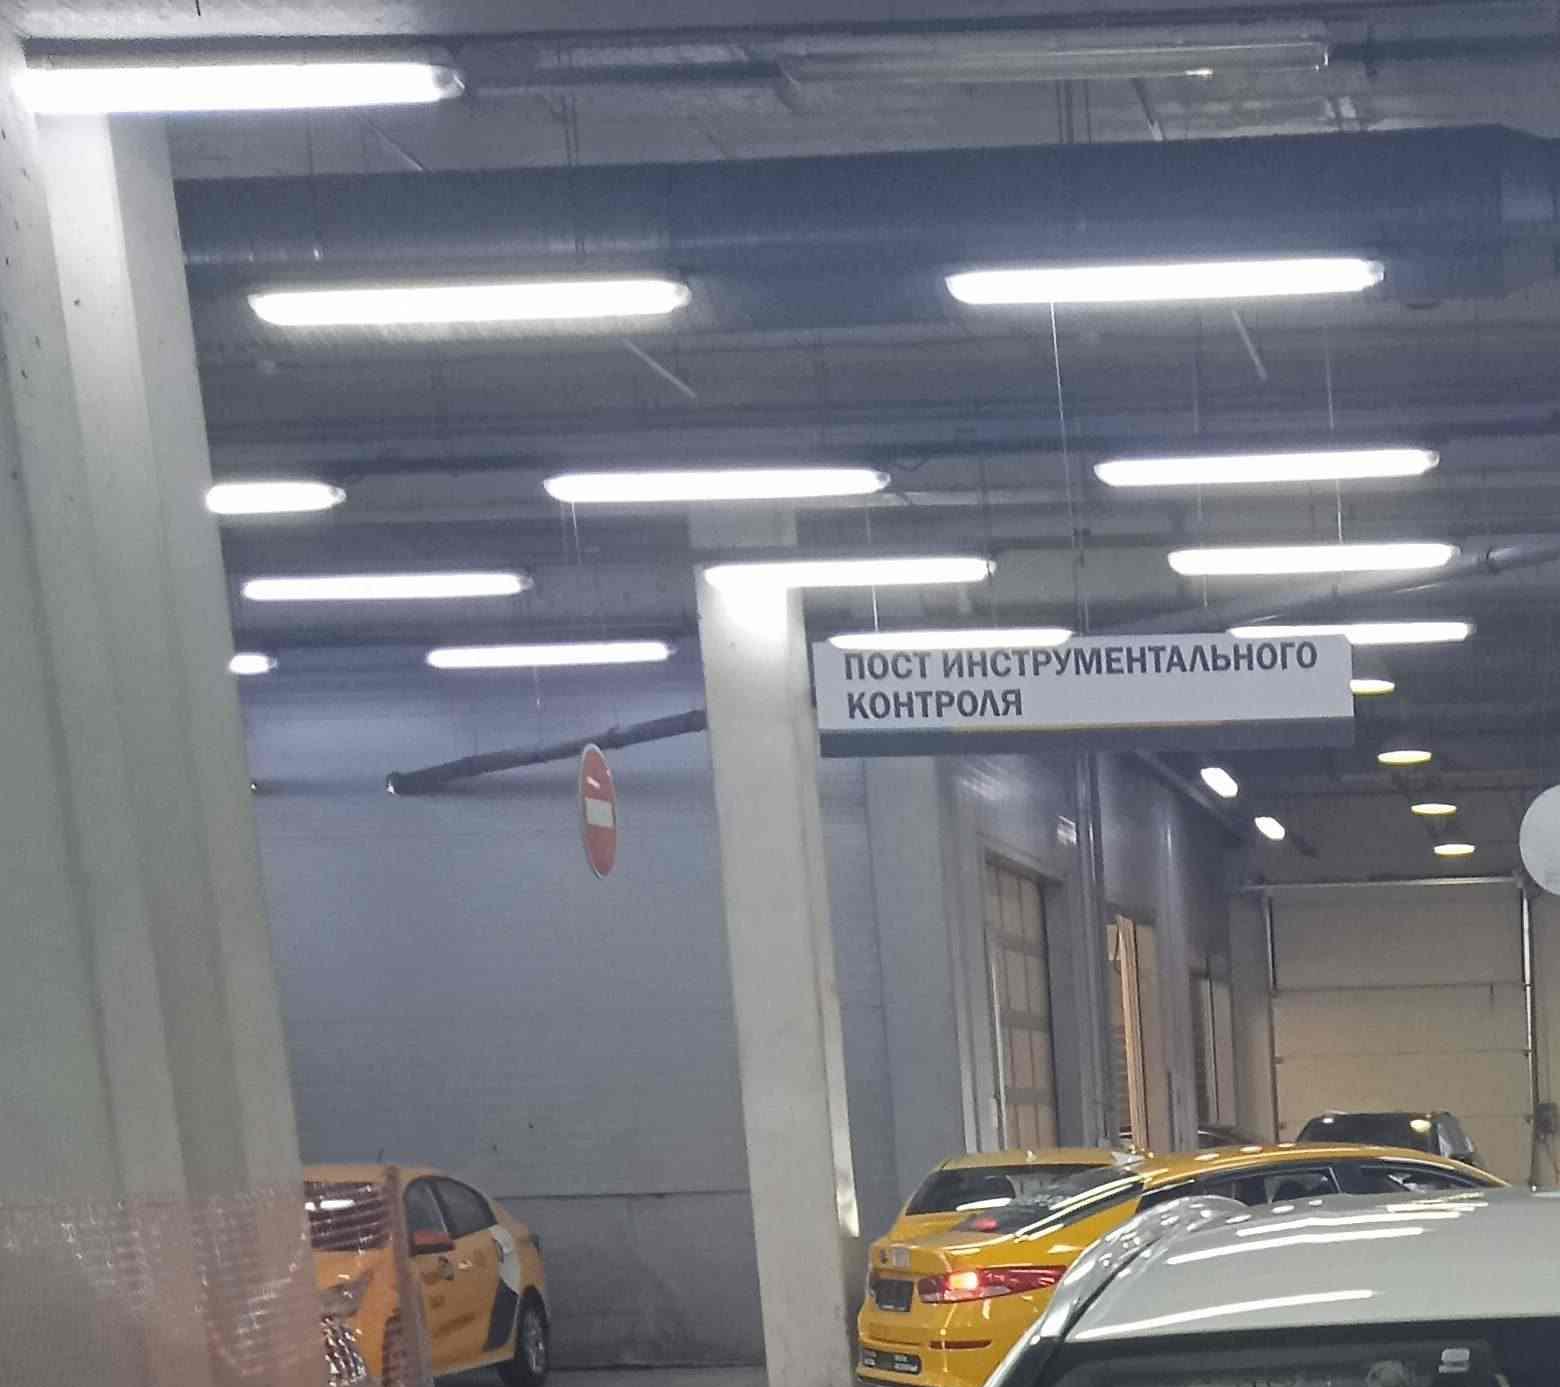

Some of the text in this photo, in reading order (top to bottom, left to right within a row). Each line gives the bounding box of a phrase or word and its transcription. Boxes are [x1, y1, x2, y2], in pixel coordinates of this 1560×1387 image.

[843, 641, 1319, 681] ПОСТ ИНСТРУМЕНТАЛЬНОГО
[847, 688, 1023, 720] КОНТРОЛЯ
